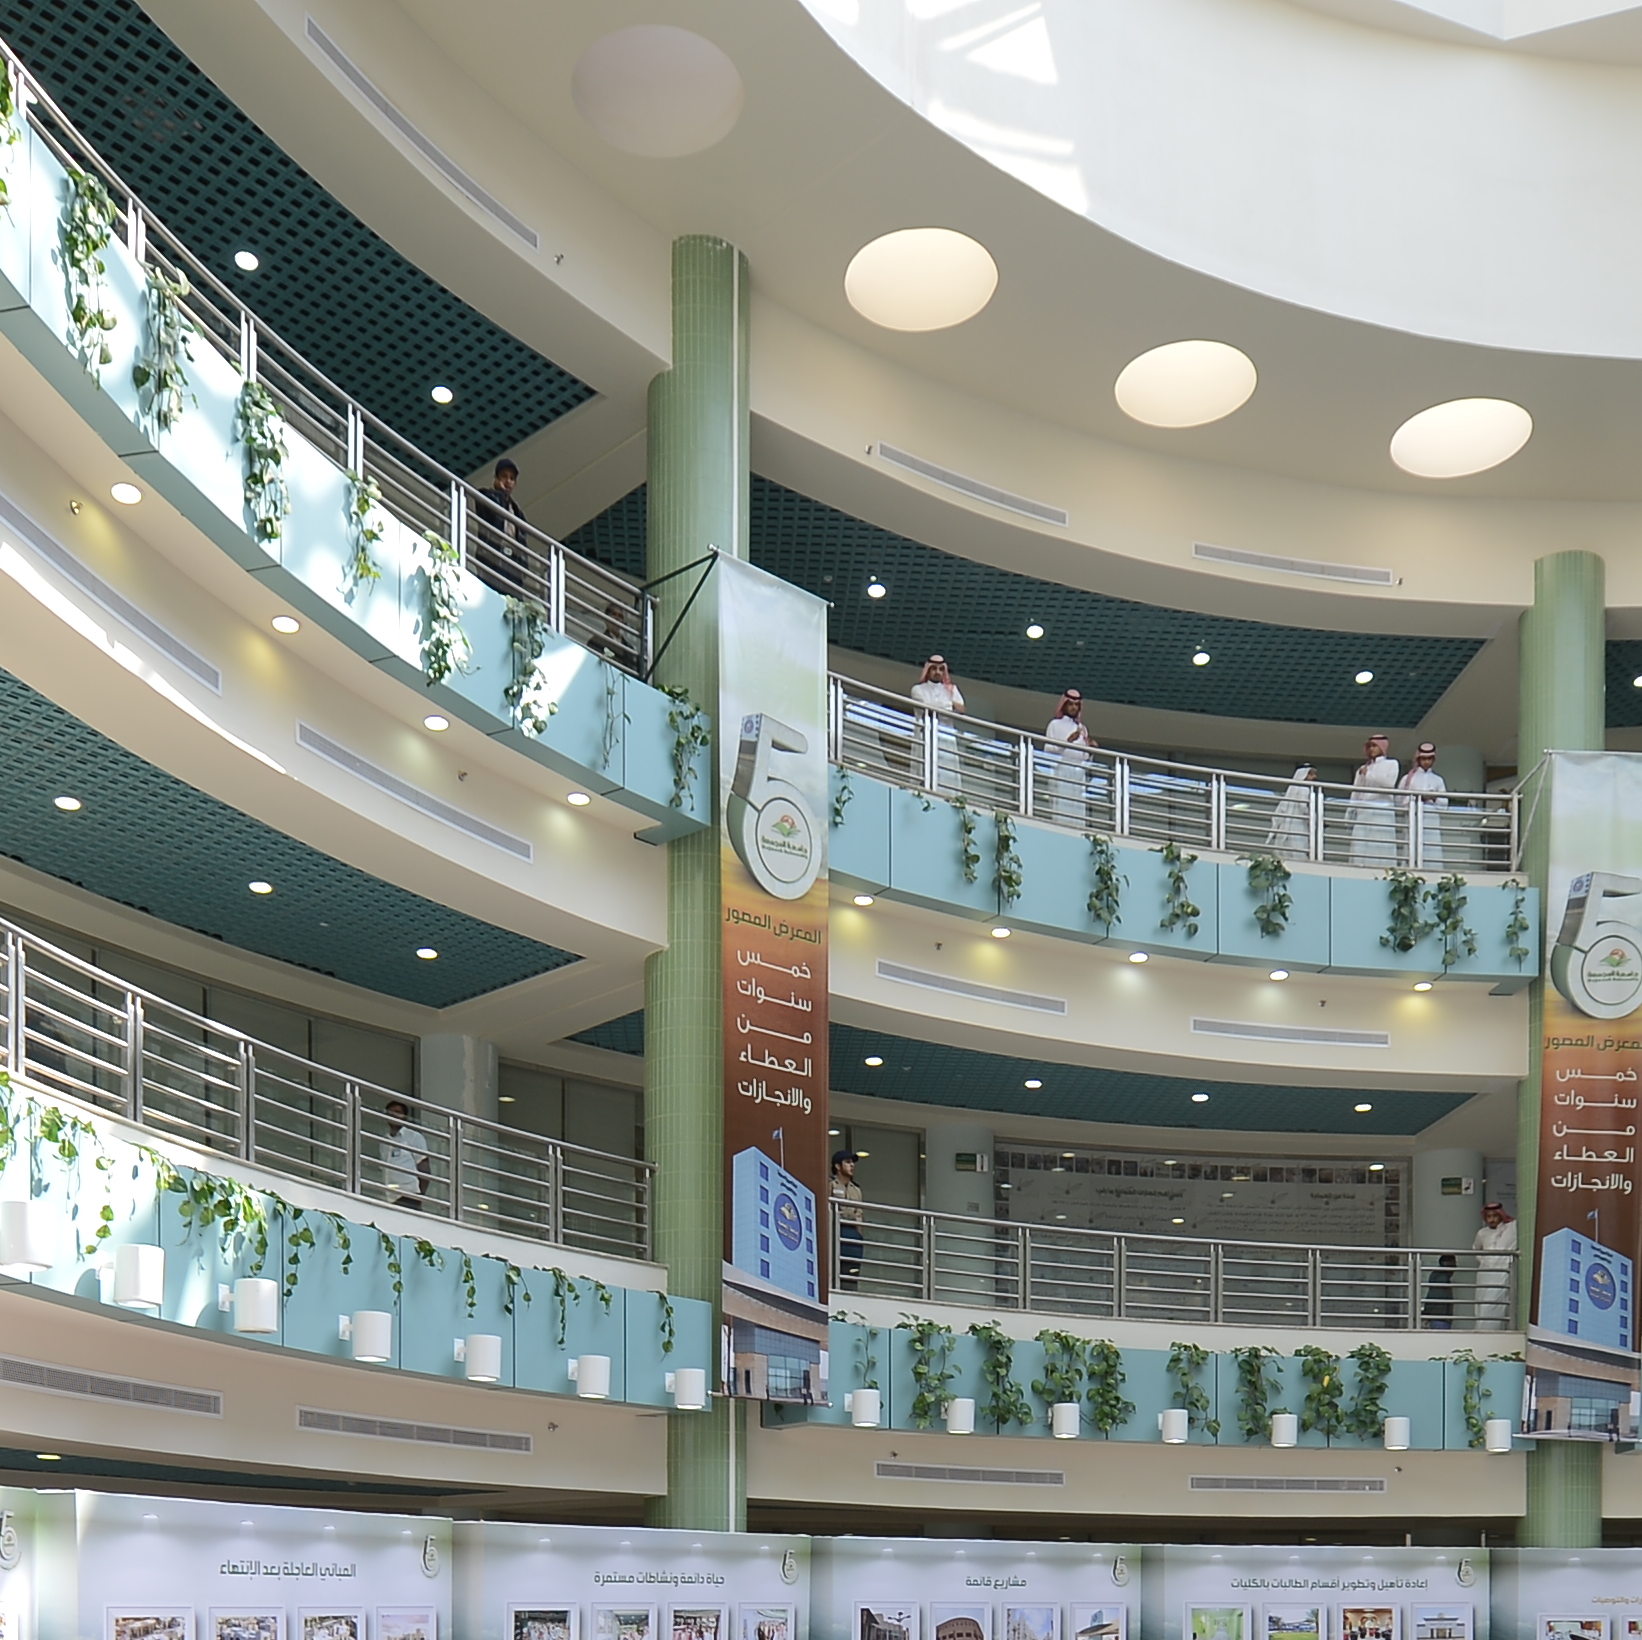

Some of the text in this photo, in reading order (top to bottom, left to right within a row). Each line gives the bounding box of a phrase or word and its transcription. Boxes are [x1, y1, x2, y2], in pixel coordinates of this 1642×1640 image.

[725, 906, 822, 945] المعرض المصور
[737, 949, 812, 979] خمس
[737, 977, 812, 1012] سنوات
[737, 1013, 812, 1044] من
[1545, 1035, 1595, 1050] المصور
[739, 1044, 812, 1078] العطاء
[1556, 1067, 1637, 1082] خمس
[737, 1078, 812, 1115] والانجازات
[1554, 1089, 1637, 1110] سنوات
[1553, 1120, 1636, 1137] من
[1553, 1144, 1634, 1163] العطاء
[1550, 1171, 1633, 1195] والانجازات
[262, 1562, 281, 1580] بعد
[282, 1561, 318, 1582] العاجلة
[319, 1562, 357, 1582] المباني
[594, 1569, 725, 1588] حياة دائمة ونشاطات مستمرة
[965, 1574, 1027, 1590] مشاريع قائمة
[1230, 1577, 1270, 1591] بالكليات
[1271, 1577, 1309, 1590] الطالبات
[1310, 1575, 1340, 1591] أقسام
[1341, 1577, 1376, 1591] وتطوير
[1377, 1576, 1403, 1591] تأهيل
